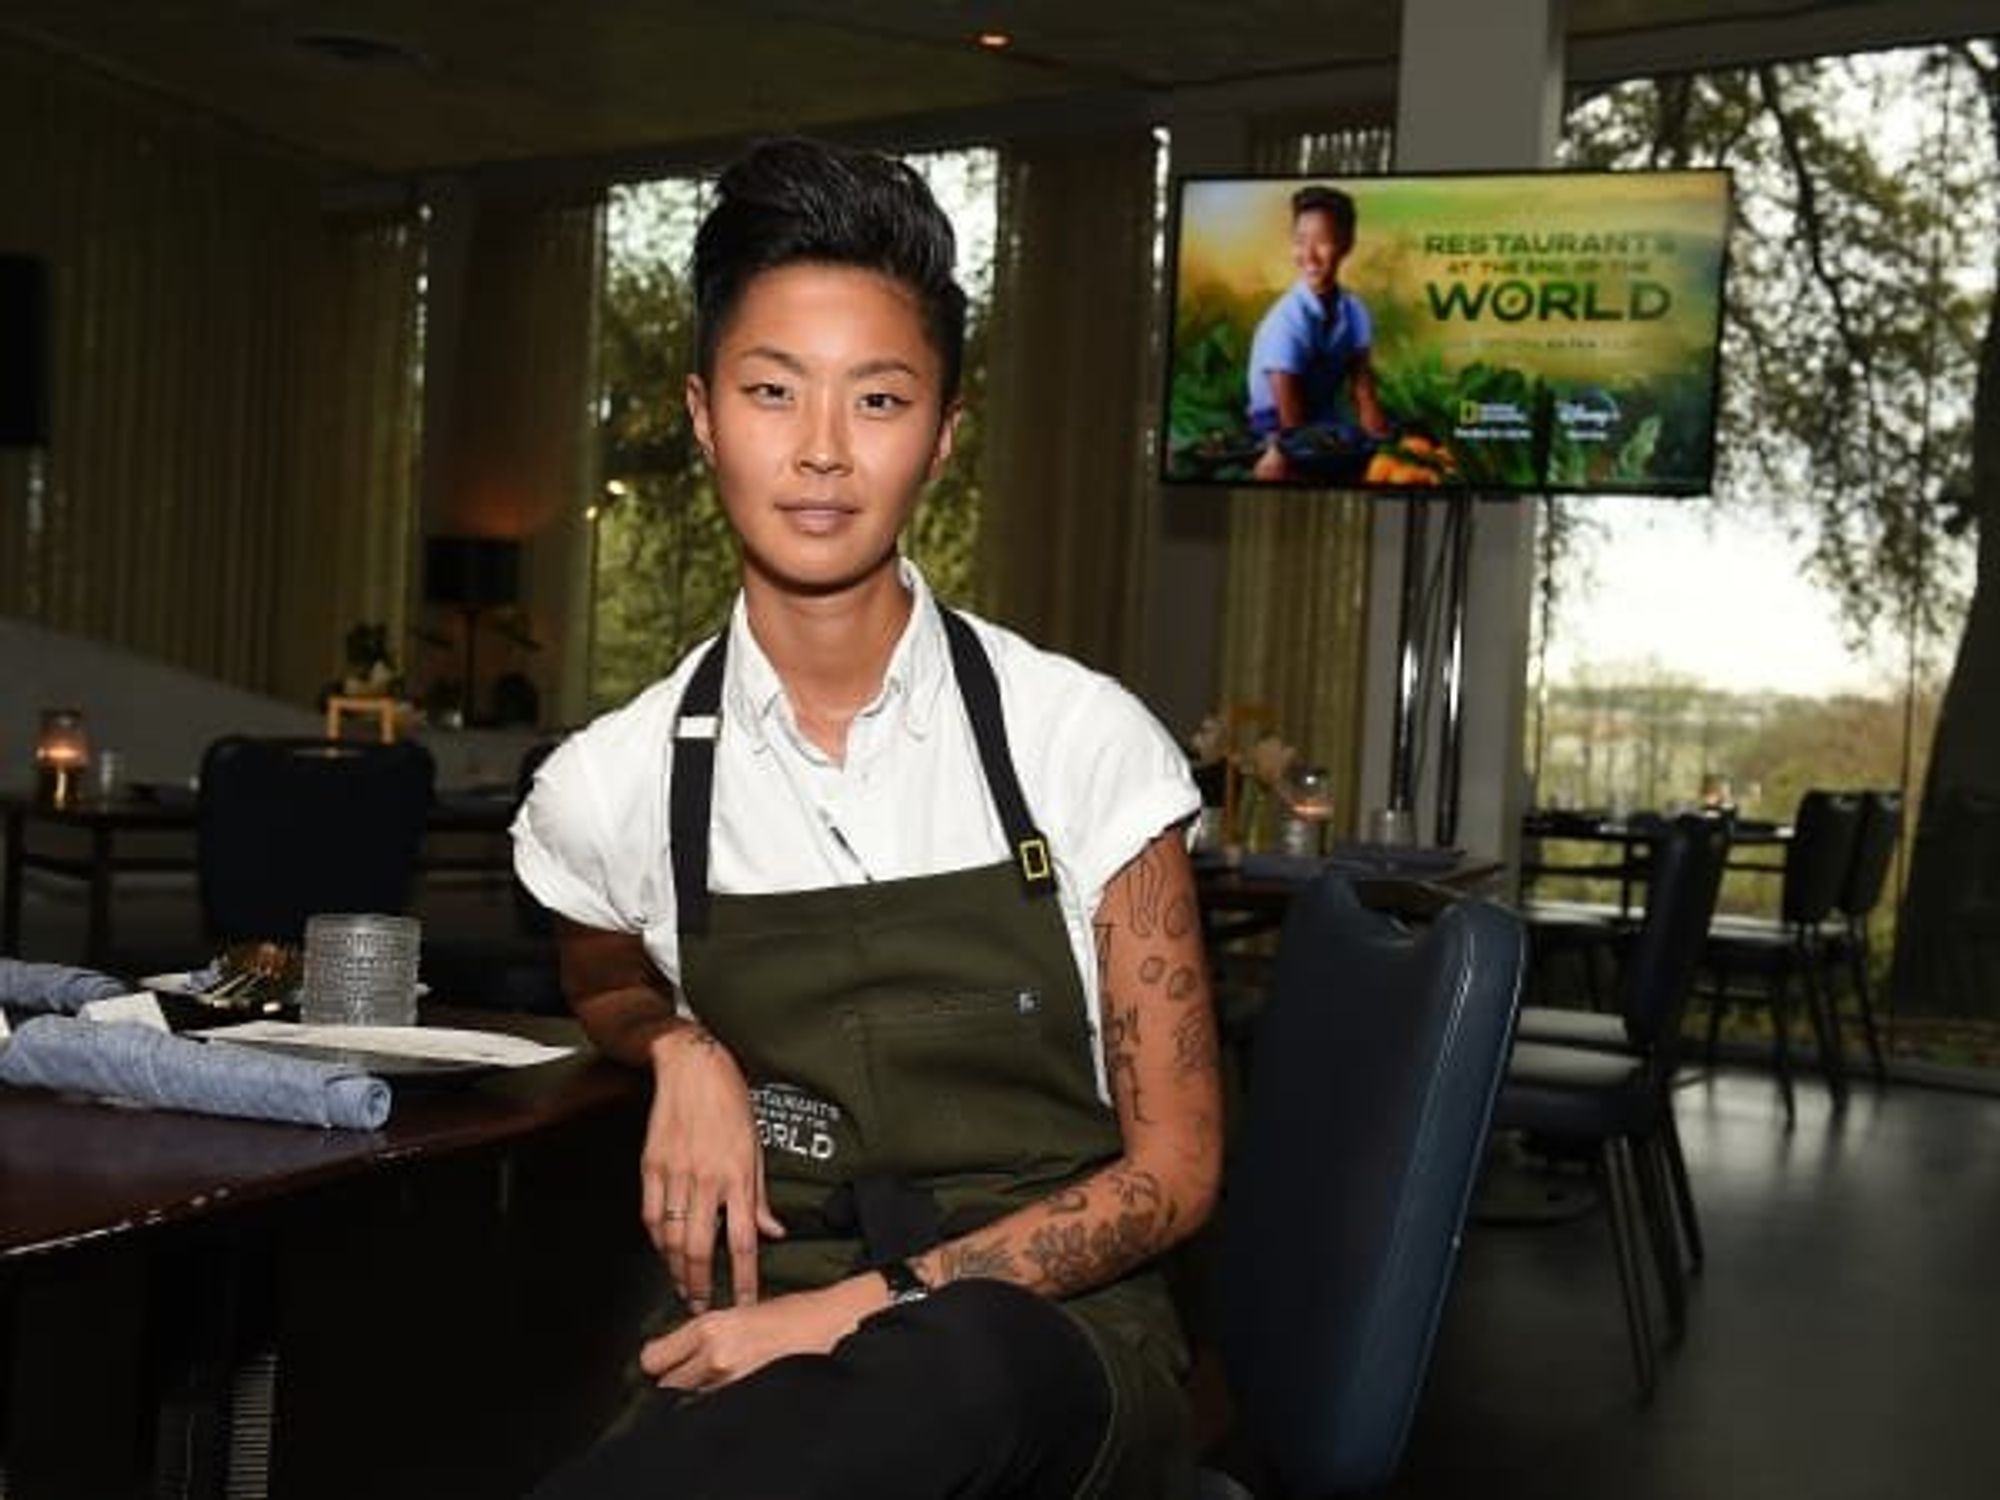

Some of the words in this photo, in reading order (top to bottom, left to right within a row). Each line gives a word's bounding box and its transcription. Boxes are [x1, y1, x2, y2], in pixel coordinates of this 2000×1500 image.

[1424, 232, 1677, 255] RESTAURANTS
[1426, 280, 1672, 322] WORLD
[756, 1119, 835, 1159] ORLD
